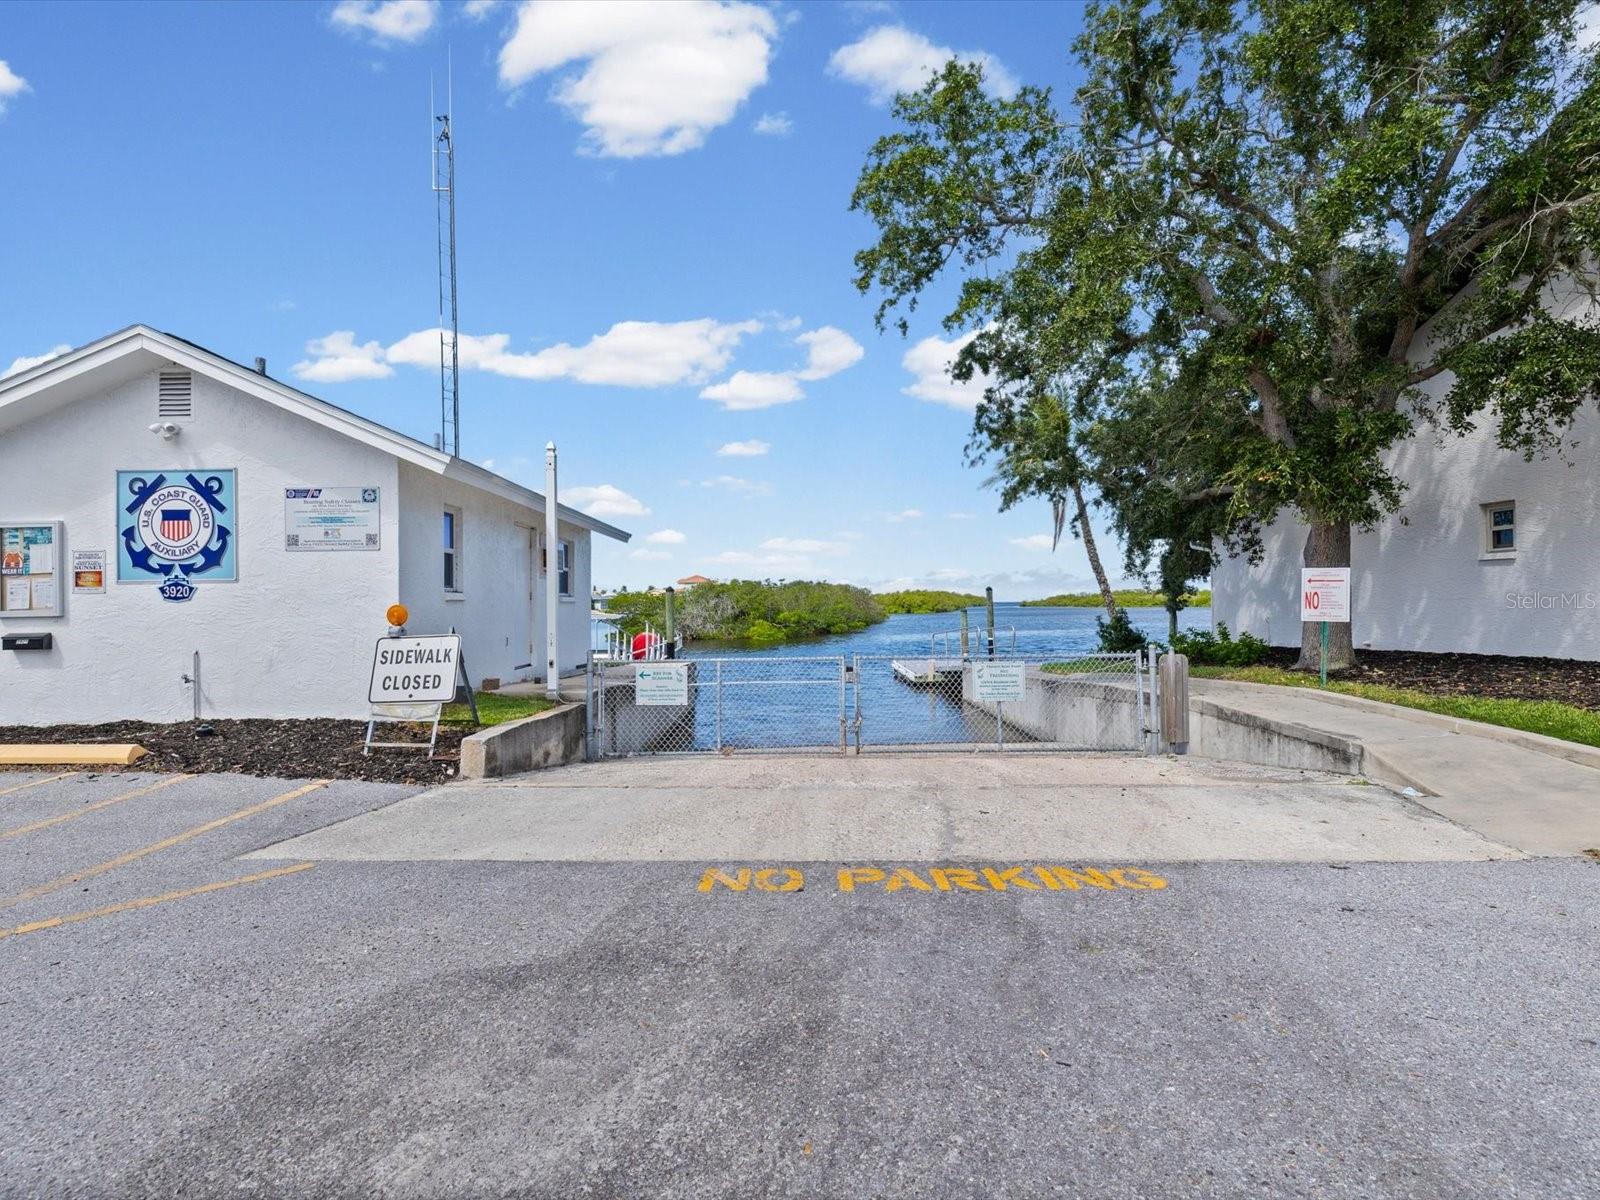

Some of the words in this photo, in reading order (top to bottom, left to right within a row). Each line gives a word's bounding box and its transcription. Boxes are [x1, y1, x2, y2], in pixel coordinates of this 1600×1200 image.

[142, 508, 153, 528] U.S.
[151, 490, 187, 506] COAST
[189, 494, 211, 529] GUARD
[151, 540, 200, 557] AUXILIARY
[163, 586, 190, 597] 3920
[1305, 592, 1319, 609] NO
[380, 648, 452, 665] SIDEWALK
[382, 675, 441, 691] CLOSED
[698, 867, 804, 892] NO
[837, 865, 1168, 892] PARKING
